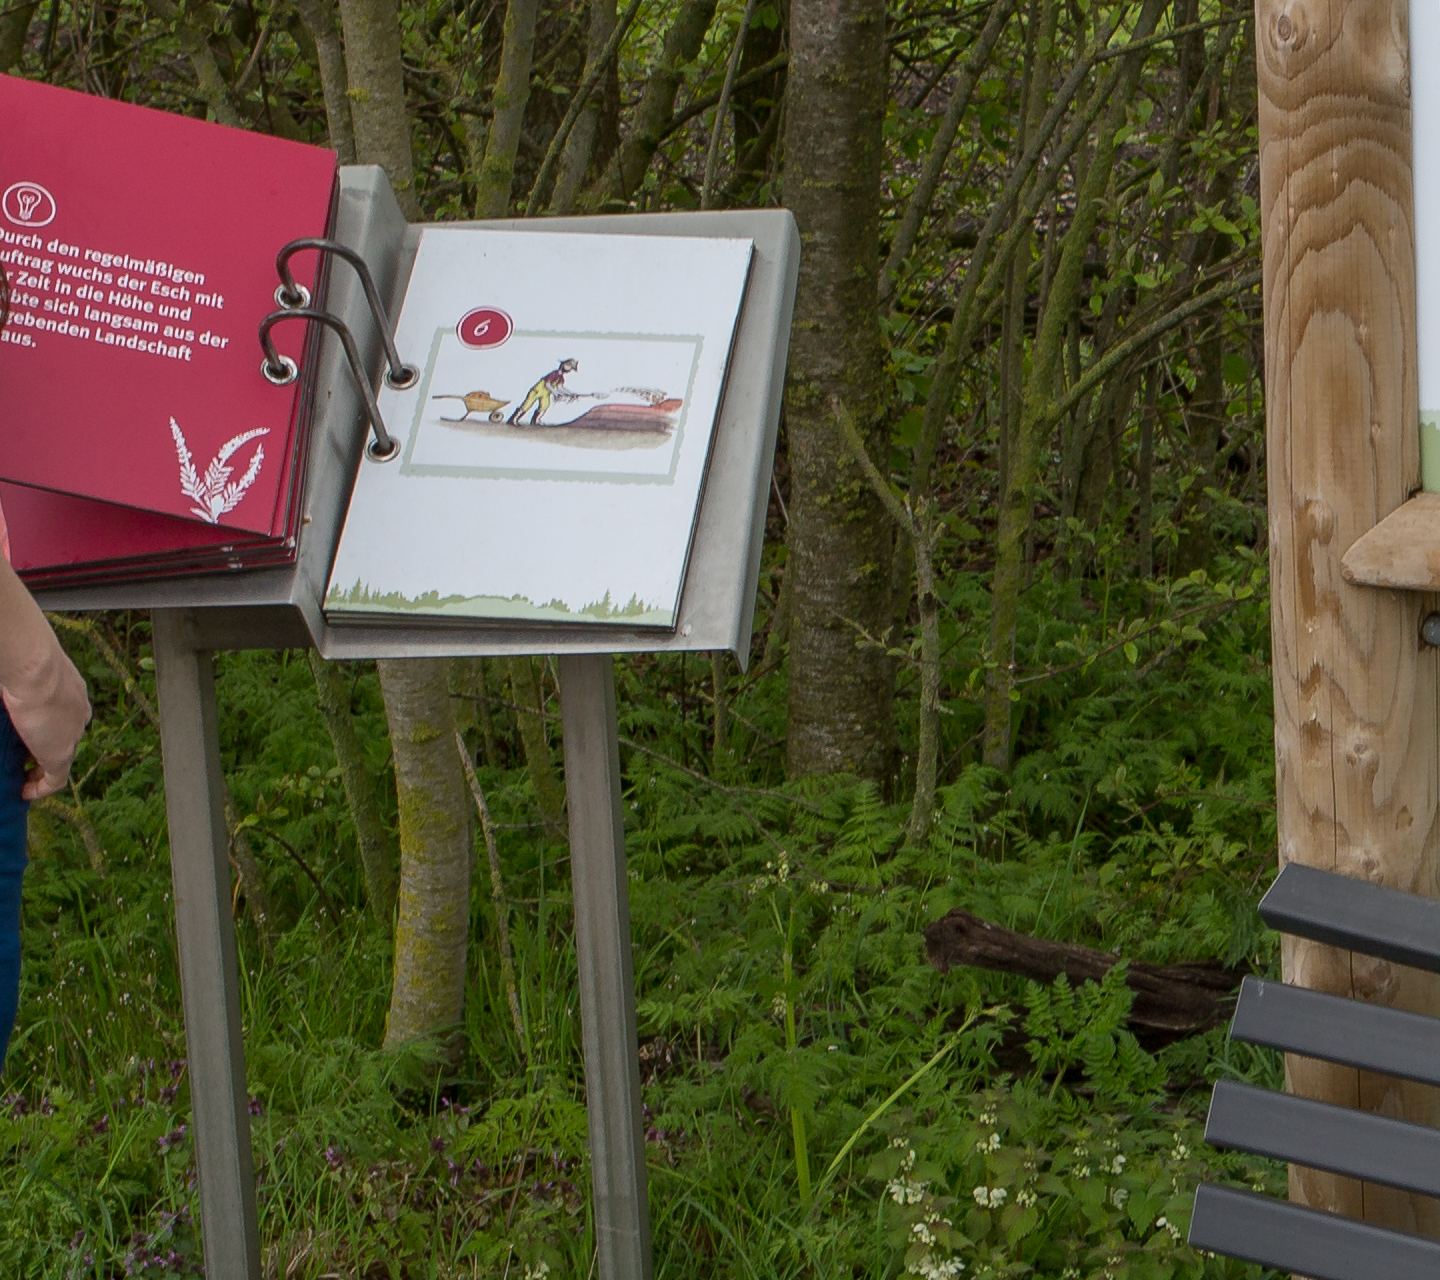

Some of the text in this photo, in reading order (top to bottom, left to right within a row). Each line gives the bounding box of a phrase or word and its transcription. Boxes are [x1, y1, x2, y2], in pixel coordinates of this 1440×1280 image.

[46, 238, 80, 259] den
[84, 248, 205, 285] regelmäßigen
[16, 270, 51, 291] Zeit
[54, 278, 71, 296] in
[76, 283, 104, 303] die
[108, 290, 154, 314] Höhe
[158, 303, 192, 322] und
[57, 262, 113, 285] wuchs
[117, 273, 148, 292] der
[150, 280, 190, 302] Esch
[195, 292, 224, 310] mit
[43, 297, 79, 317] sich
[84, 304, 159, 335] langsam
[163, 325, 195, 342] aus
[199, 330, 229, 349] der
[95, 328, 192, 361] Landschaft
[473, 318, 492, 337] 6
